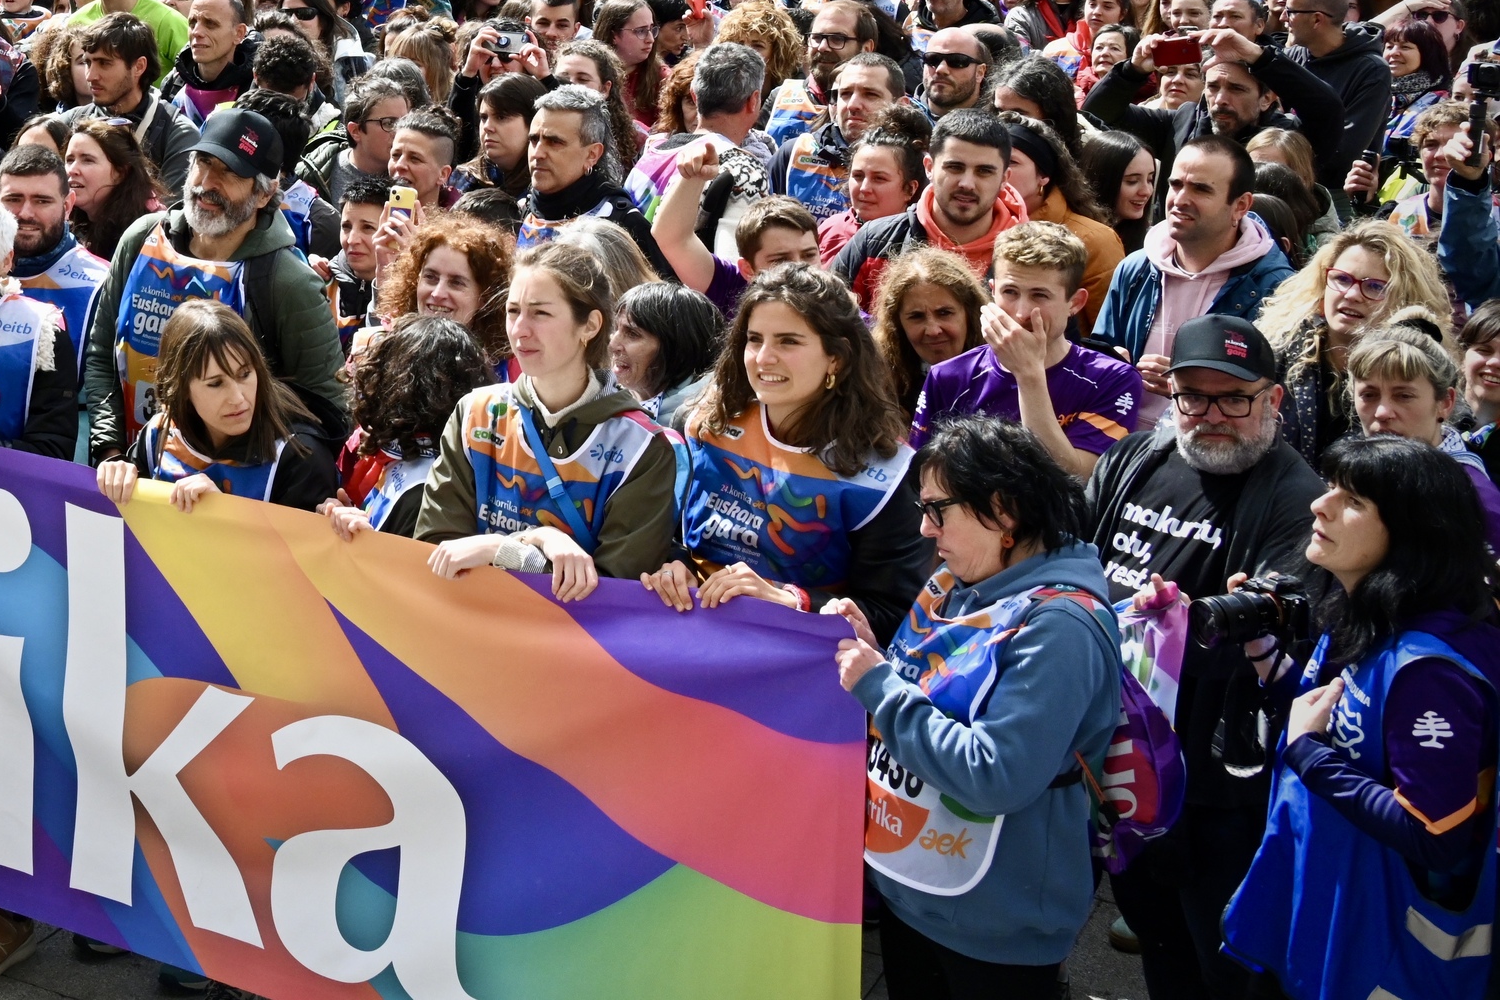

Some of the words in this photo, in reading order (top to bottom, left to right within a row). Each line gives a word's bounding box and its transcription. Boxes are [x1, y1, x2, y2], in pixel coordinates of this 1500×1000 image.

[132, 293, 179, 317] Euskar
[141, 285, 171, 300] 24.korrika
[2, 323, 32, 335] eitb
[1227, 348, 1247, 358] gara
[706, 491, 765, 531] Euskara
[1120, 502, 1222, 550] makurtu,
[702, 514, 759, 549] gara
[1112, 530, 1152, 565] otu,
[918, 827, 973, 859] aek
